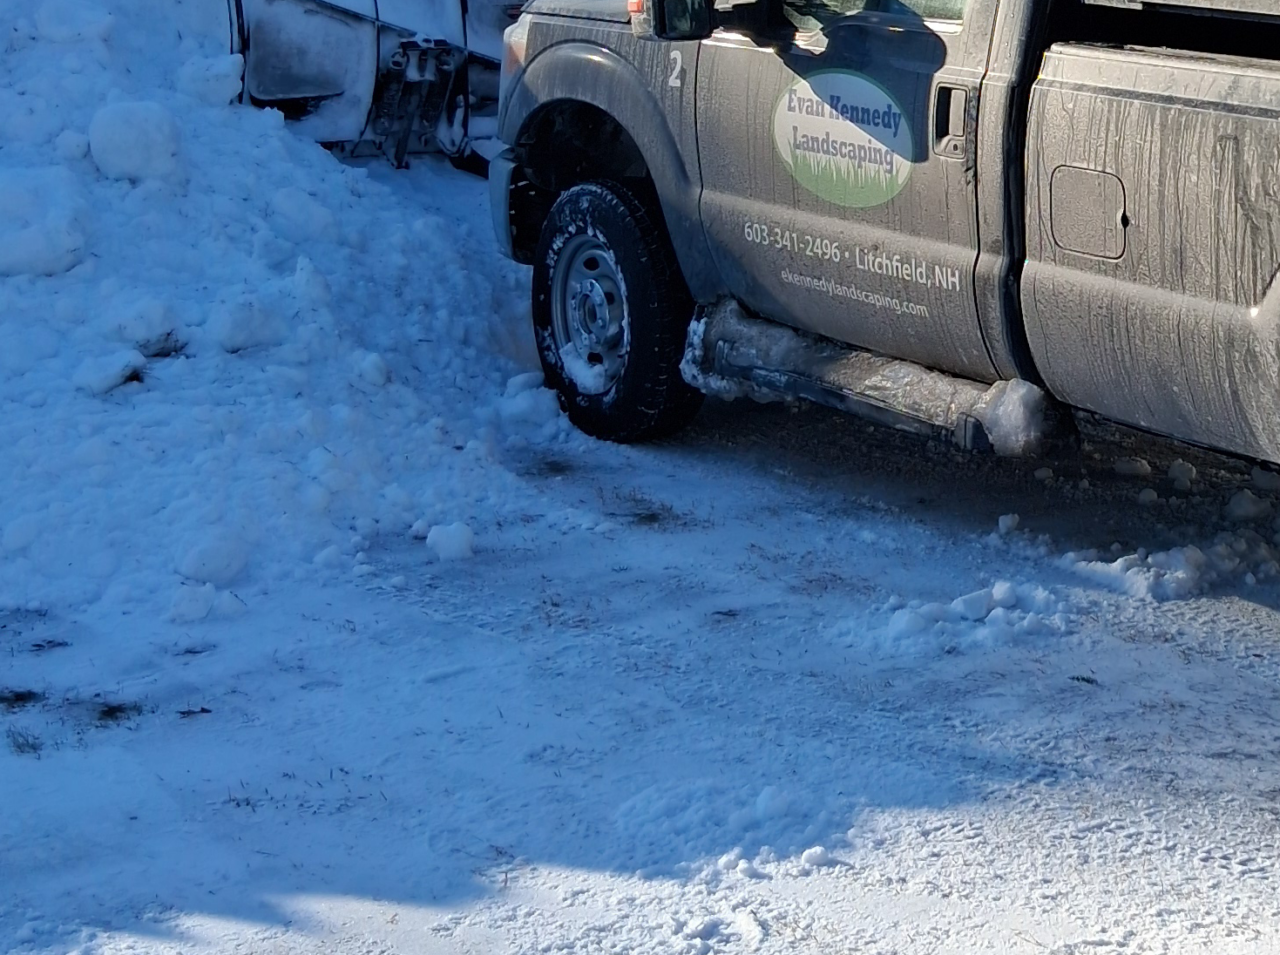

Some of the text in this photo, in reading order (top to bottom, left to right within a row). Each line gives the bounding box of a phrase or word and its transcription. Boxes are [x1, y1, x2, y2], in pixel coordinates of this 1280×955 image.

[669, 50, 682, 87] 2
[787, 88, 902, 138] Evan Kennedy
[792, 125, 895, 174] Landscaping
[744, 221, 961, 292] 603-341-2496 Litchfield, NH
[781, 268, 930, 318] ekennedylandscaping.com
